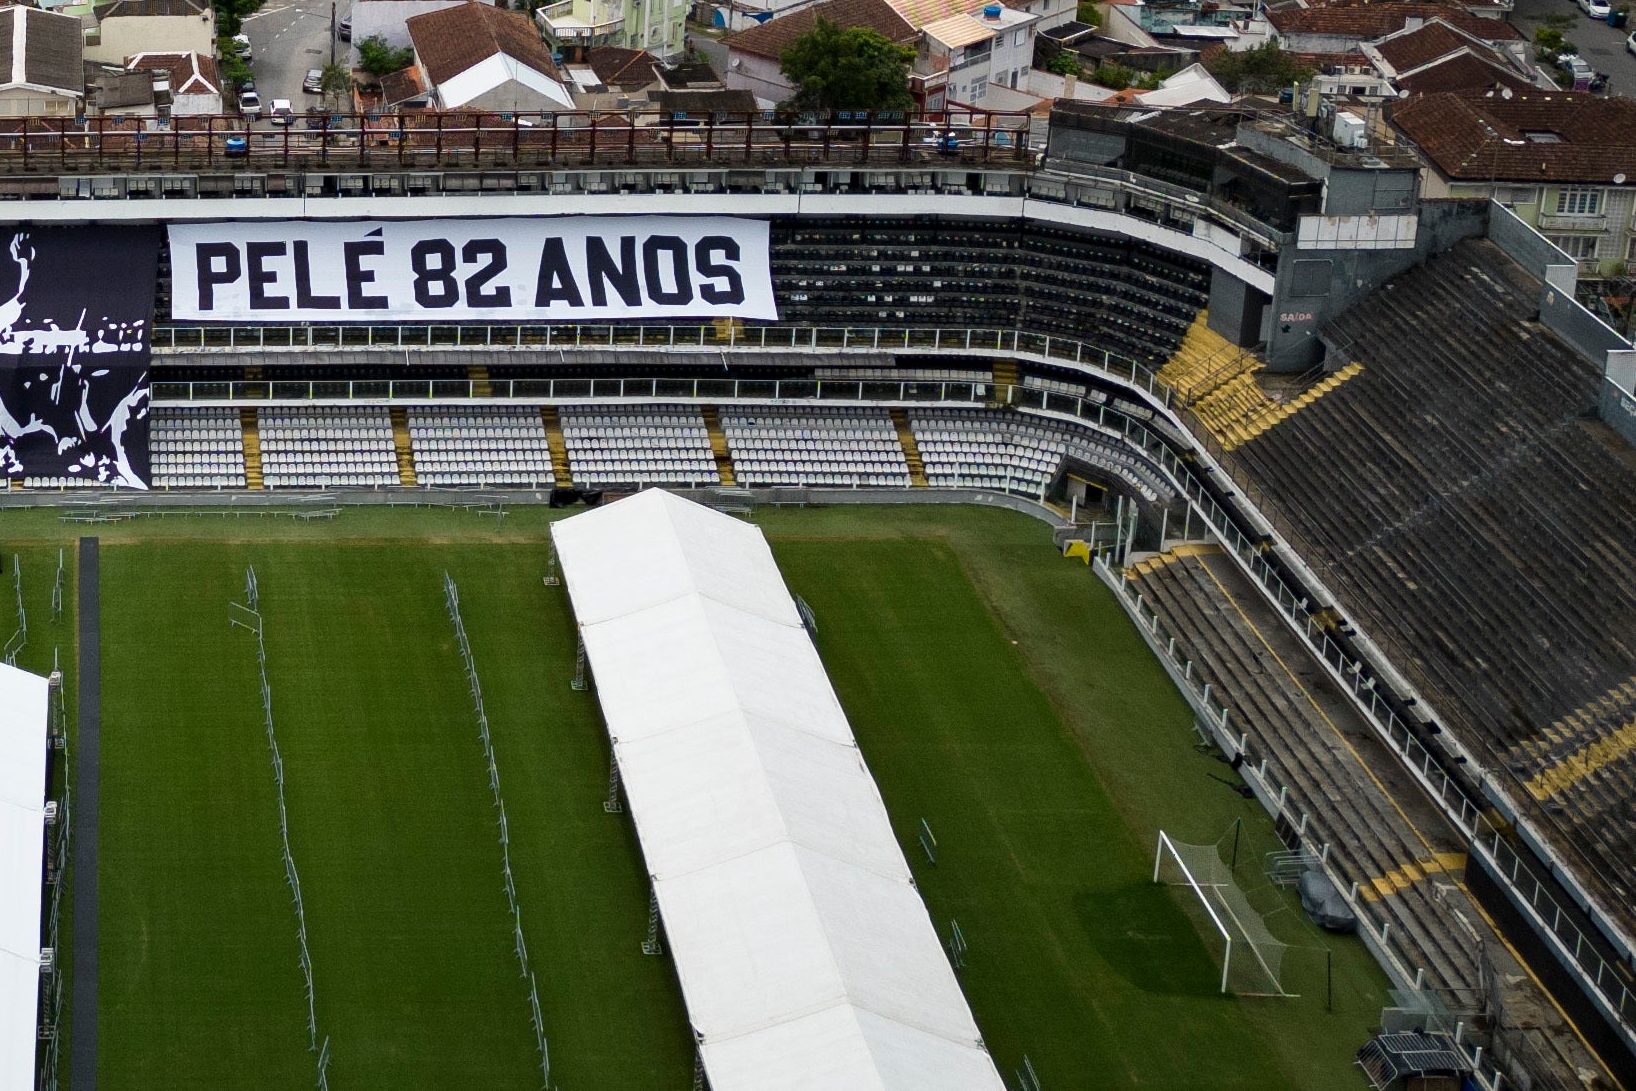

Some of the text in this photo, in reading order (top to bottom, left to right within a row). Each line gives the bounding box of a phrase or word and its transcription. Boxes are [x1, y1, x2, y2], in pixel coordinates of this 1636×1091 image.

[196, 227, 744, 310] PELÉ 82 ANOS
